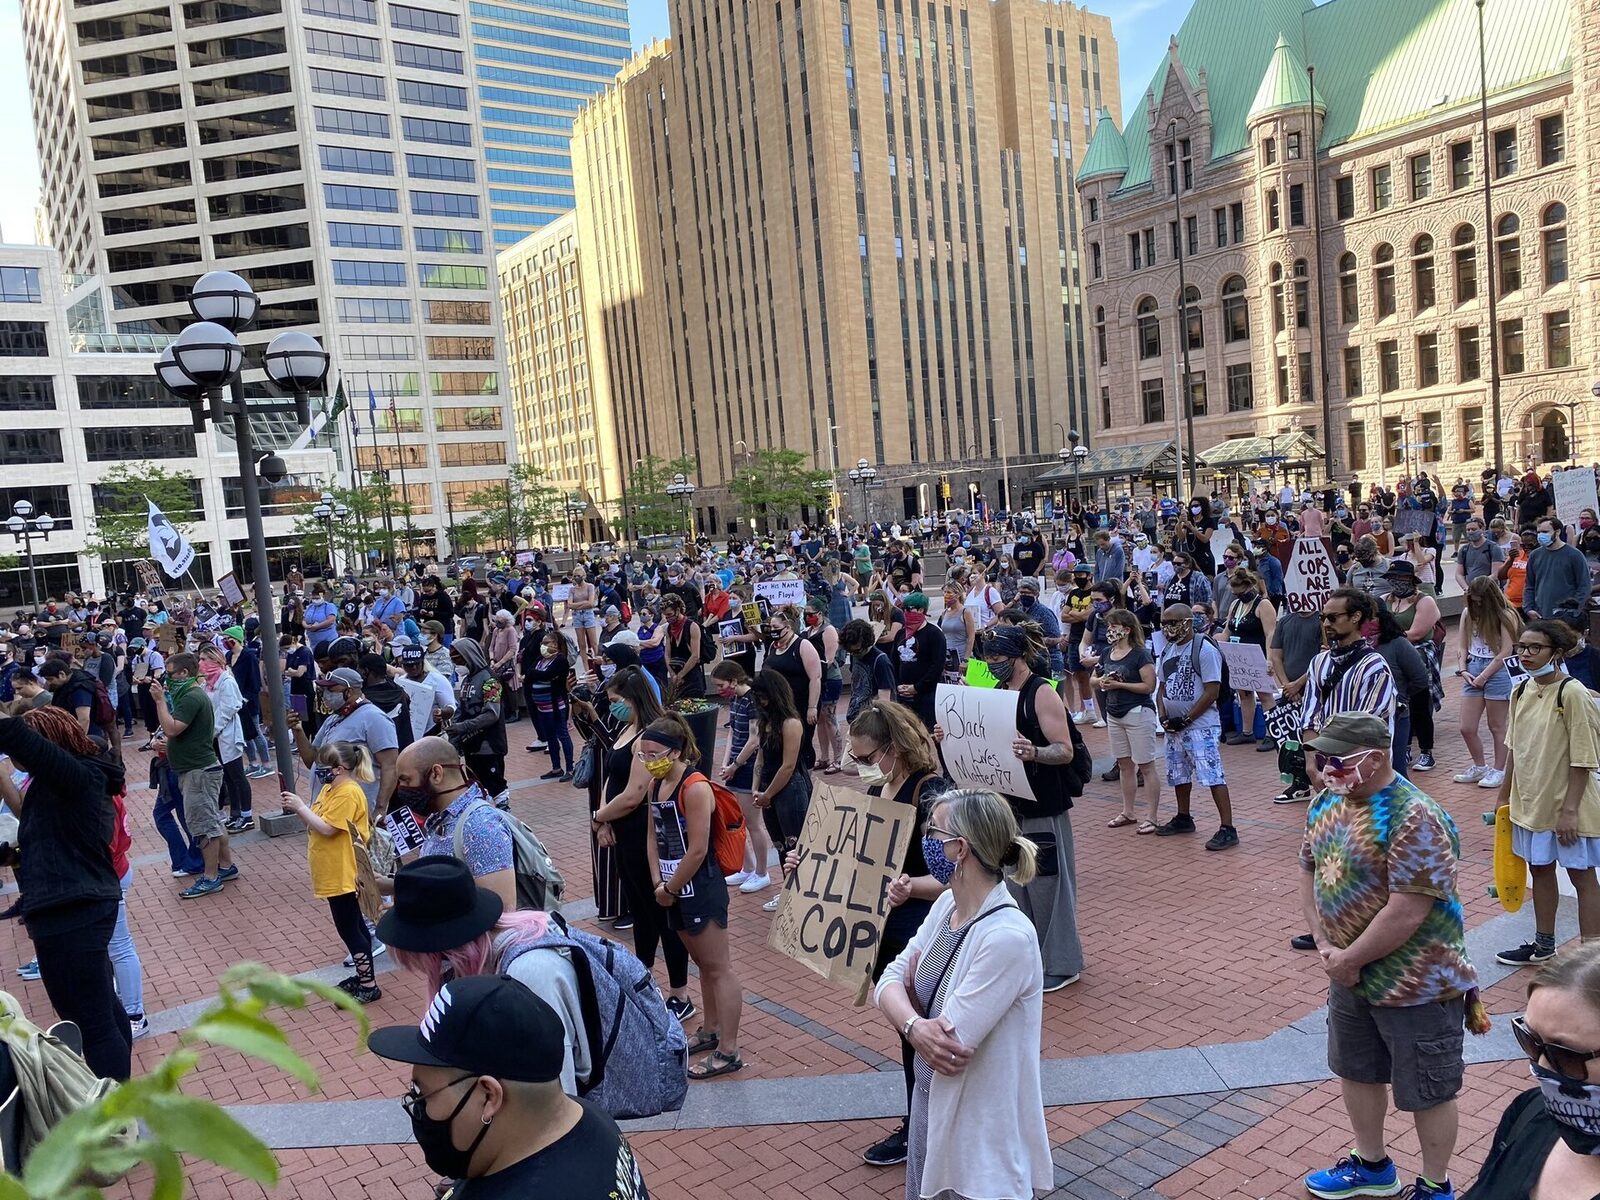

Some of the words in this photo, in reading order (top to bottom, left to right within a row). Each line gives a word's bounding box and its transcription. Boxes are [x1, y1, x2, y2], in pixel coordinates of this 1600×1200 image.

[1299, 541, 1322, 555] ALL
[1298, 556, 1329, 576] COPS
[1306, 576, 1330, 590] ARE
[778, 591, 795, 599] Floyd
[1171, 688, 1195, 696] STAND
[1173, 681, 1195, 690] EVER
[940, 690, 987, 741] Black
[1264, 703, 1292, 721] Justice
[967, 741, 1001, 767] Lives
[400, 808, 423, 844] FLOYD
[826, 805, 900, 870] JAIL
[785, 844, 892, 917] KILLE
